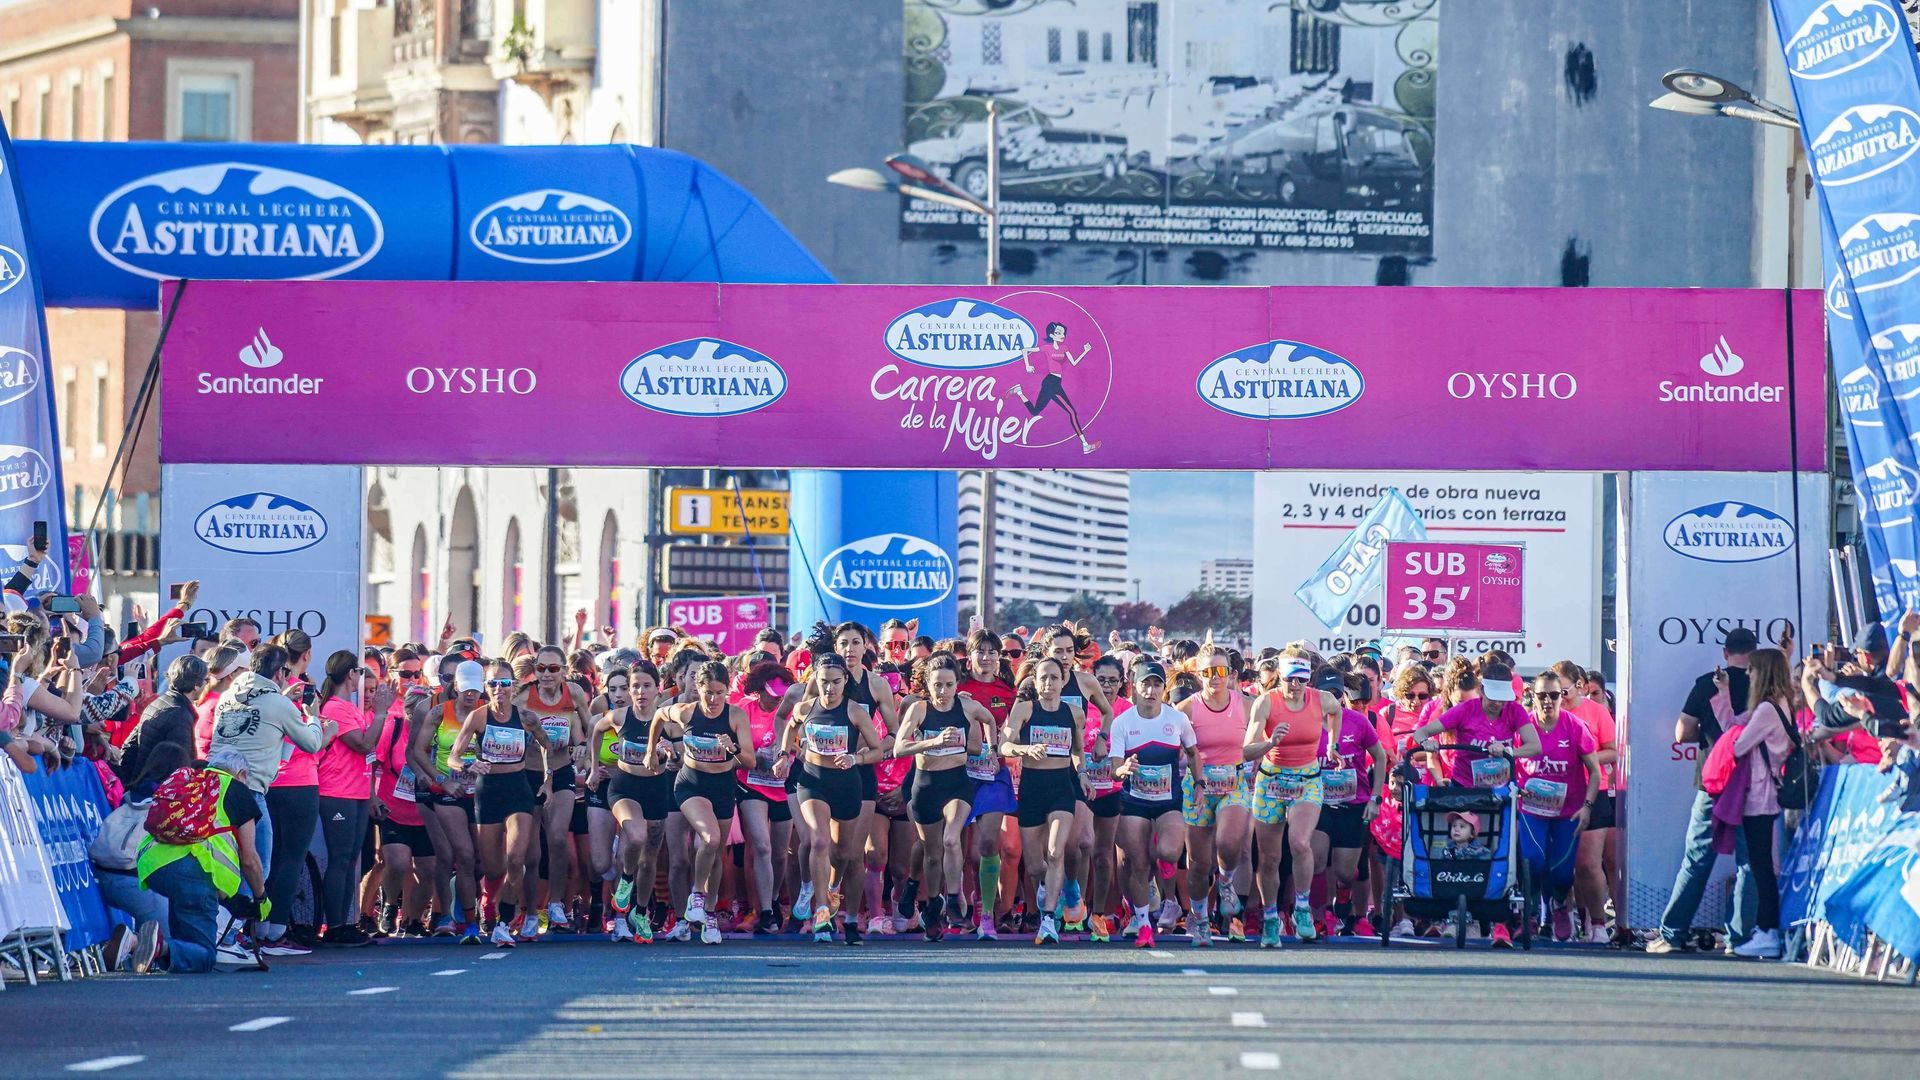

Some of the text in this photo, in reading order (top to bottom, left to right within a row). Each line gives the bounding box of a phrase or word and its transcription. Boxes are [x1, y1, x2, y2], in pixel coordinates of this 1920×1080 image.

[158, 203, 352, 217] CENTRAL LECHERA
[508, 214, 615, 222] CENTRAL LECHERA
[112, 203, 361, 258] ASTURIANA
[483, 218, 620, 245] ASTURIANA
[896, 323, 1025, 352] ASTURIANA
[920, 322, 1023, 331] CENTRAL LECHERA
[407, 367, 537, 394] OYSHO
[633, 365, 774, 398] ASTURIANA
[660, 365, 770, 374] CENTRAL LECHERA
[1235, 367, 1347, 377] CENTRAL LECHERA
[198, 372, 323, 395] Santander
[871, 364, 997, 402] Carrera
[1210, 368, 1352, 400] ASTURIANA
[1447, 371, 1578, 399] OYSHO
[1658, 379, 1784, 403] Santander
[901, 400, 1044, 461] de la Mujer
[1406, 483, 1429, 499] de
[1436, 484, 1478, 500] obra
[1484, 487, 1541, 501] nueva
[722, 515, 780, 529] TEMPS
[1303, 504, 1313, 518] 3
[1319, 506, 1328, 521] y
[1335, 504, 1345, 518] 4
[1462, 508, 1497, 521] con
[1502, 505, 1567, 522] terraza
[204, 514, 317, 540] ASTURIANA
[1673, 522, 1787, 548] ASTURIANA
[830, 560, 949, 591] ASTURIANA
[1405, 551, 1466, 576] SUB
[1482, 576, 1520, 586] OYSHO
[673, 604, 723, 627] SUB
[247, 709, 261, 736] GOKU
